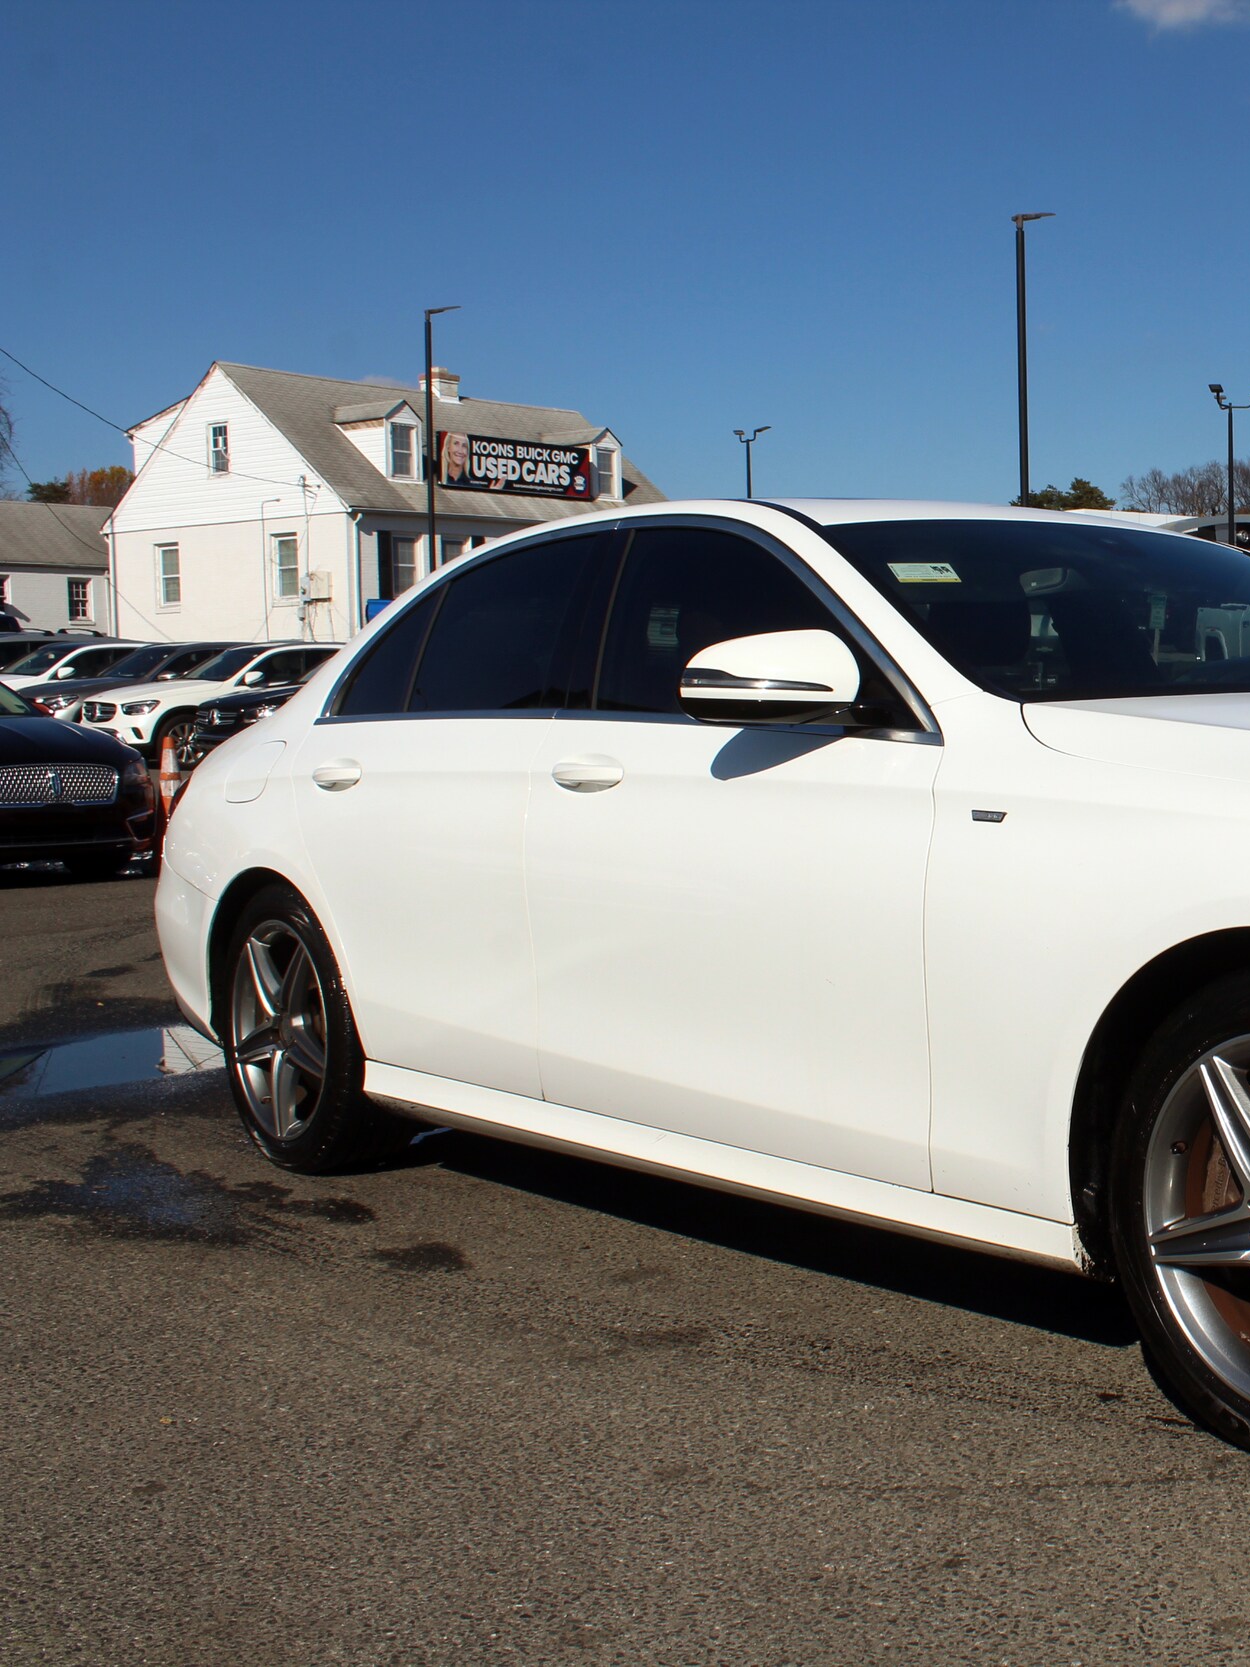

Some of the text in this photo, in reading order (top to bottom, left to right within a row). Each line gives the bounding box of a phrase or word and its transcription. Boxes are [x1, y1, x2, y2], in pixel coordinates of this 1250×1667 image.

[472, 440, 579, 465] KOONS BUICK GMC
[472, 455, 521, 481] USED
[521, 461, 571, 487] CARS
